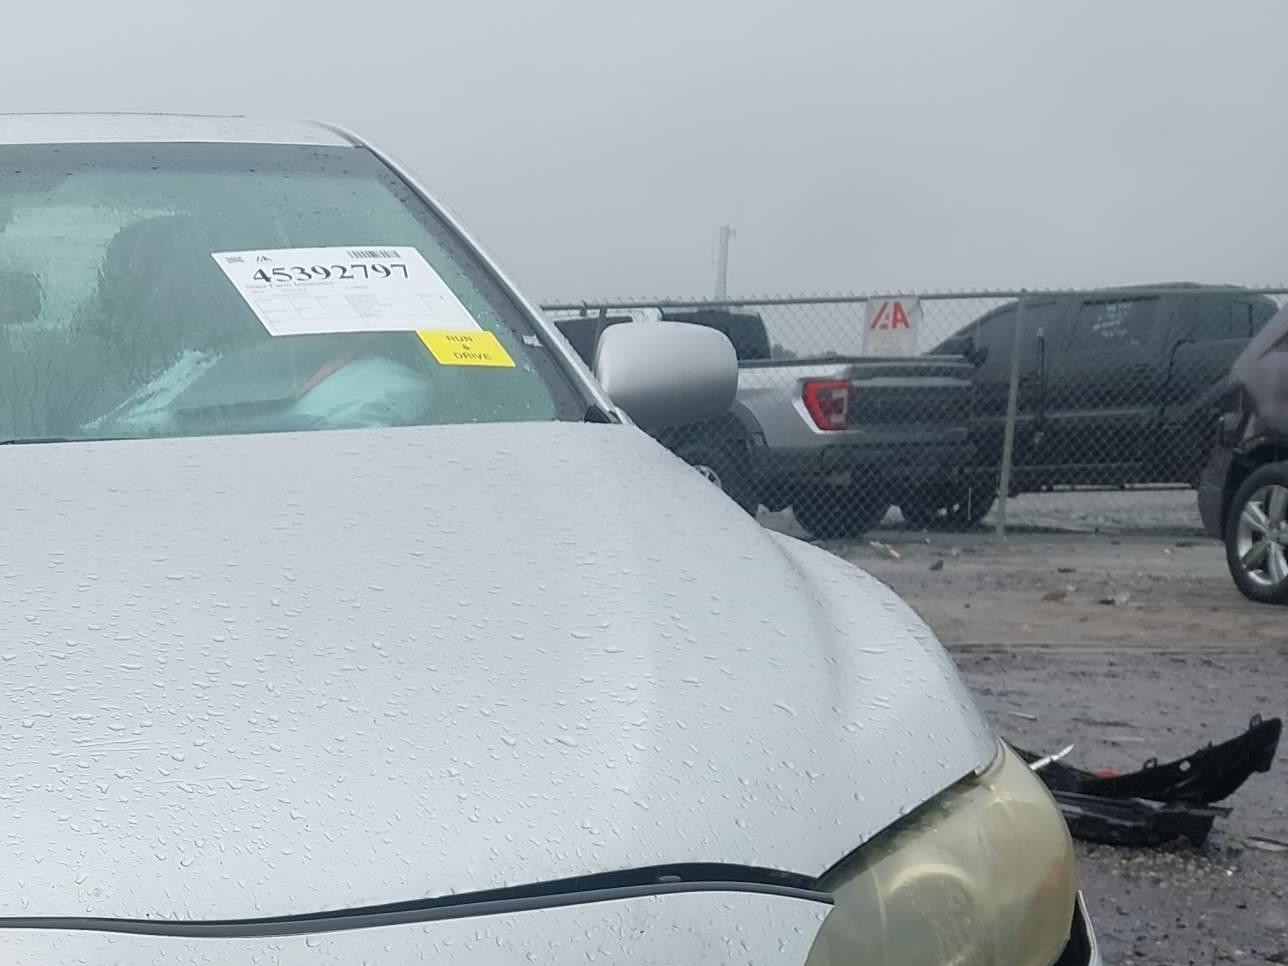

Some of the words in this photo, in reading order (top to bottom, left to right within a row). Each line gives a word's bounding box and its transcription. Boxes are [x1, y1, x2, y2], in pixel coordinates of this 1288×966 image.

[252, 263, 409, 283] 45392797
[445, 335, 474, 343] RUN
[453, 352, 493, 360] DRIVE
